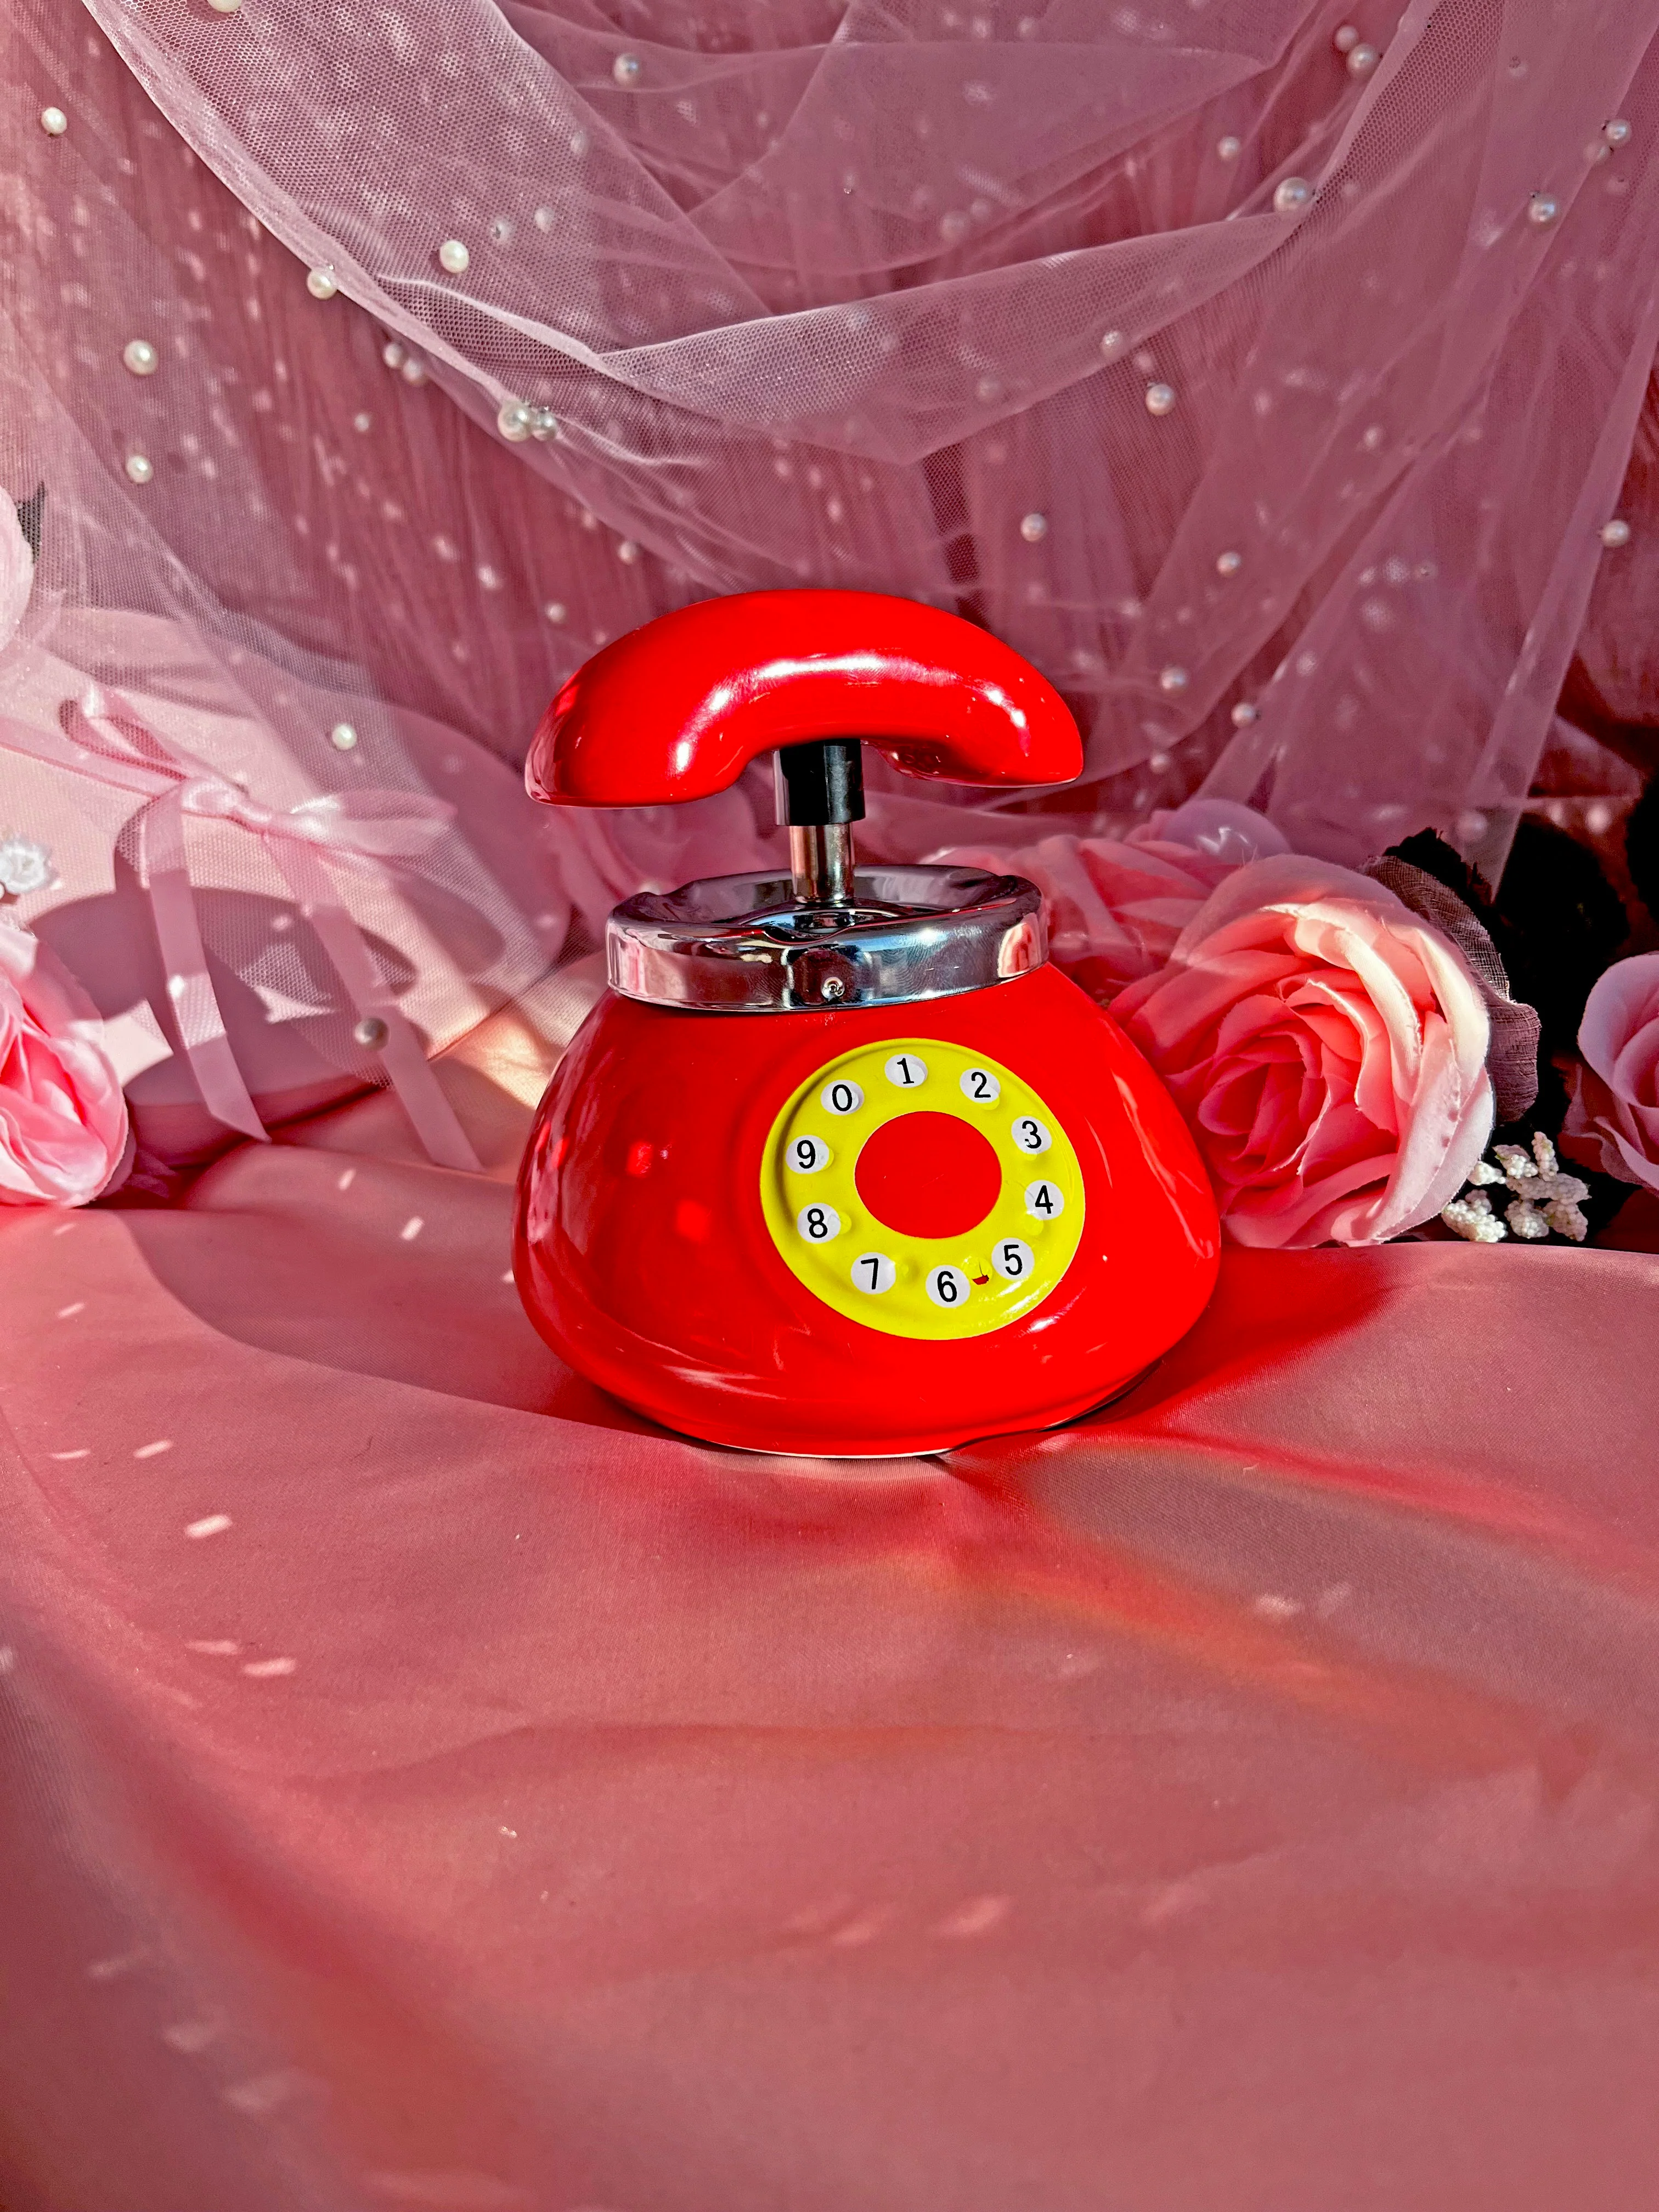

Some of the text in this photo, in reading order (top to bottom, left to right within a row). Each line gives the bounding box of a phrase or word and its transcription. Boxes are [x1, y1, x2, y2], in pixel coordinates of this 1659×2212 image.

[897, 1058, 915, 1085] 1
[971, 1071, 991, 1098] 2
[832, 1084, 853, 1112] 0
[1022, 1120, 1042, 1149] 3
[797, 1139, 816, 1169] 9
[1035, 1184, 1054, 1214] 4
[807, 1208, 828, 1238] 8
[860, 1257, 879, 1290] 7
[1003, 1244, 1023, 1276] 5
[937, 1271, 957, 1302] 6
